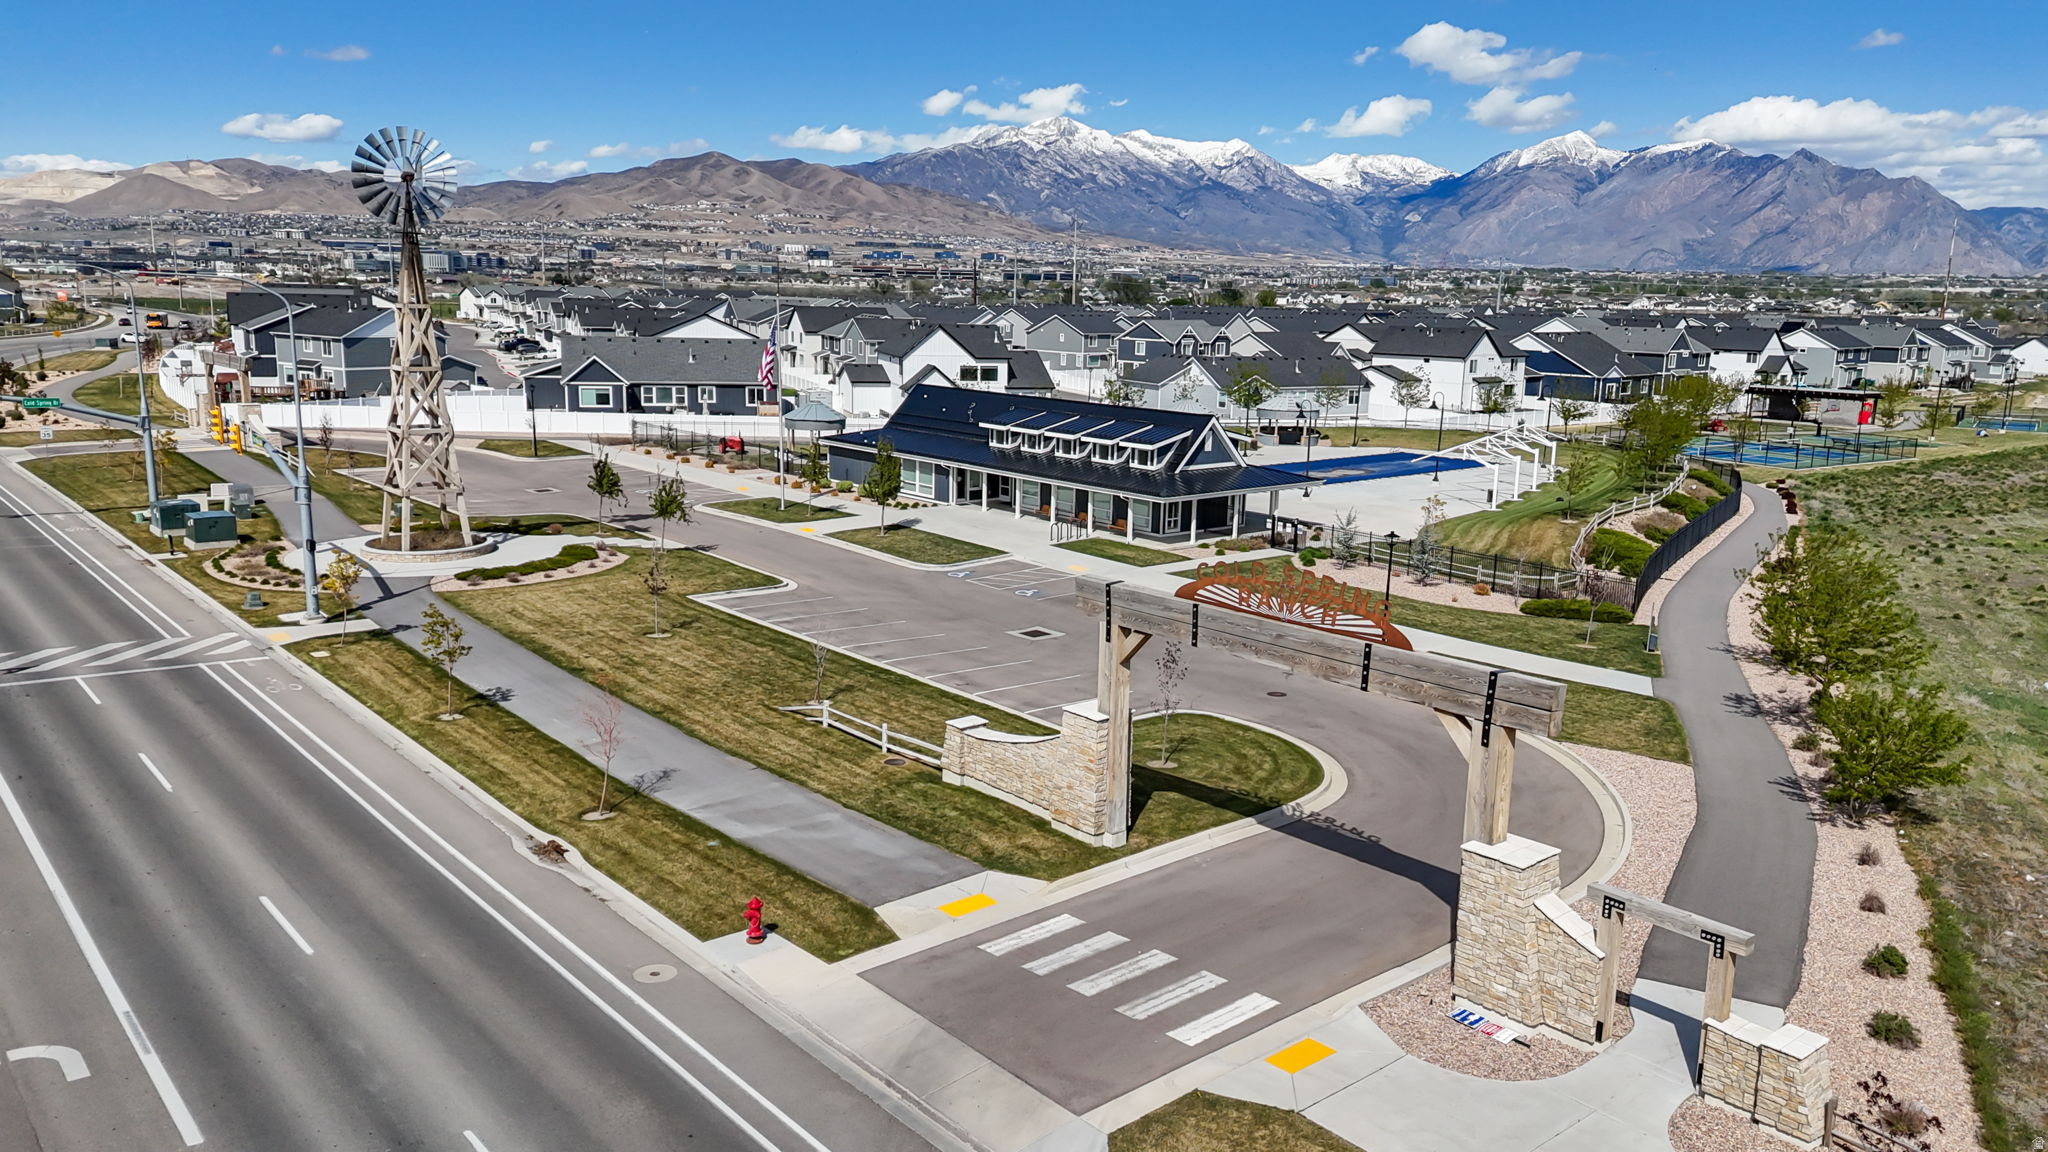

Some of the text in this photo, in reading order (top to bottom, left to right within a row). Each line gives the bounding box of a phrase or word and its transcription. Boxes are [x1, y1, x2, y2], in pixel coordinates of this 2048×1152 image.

[1197, 560, 1392, 619] COLD SPRING
[1238, 587, 1338, 628] RANCH
